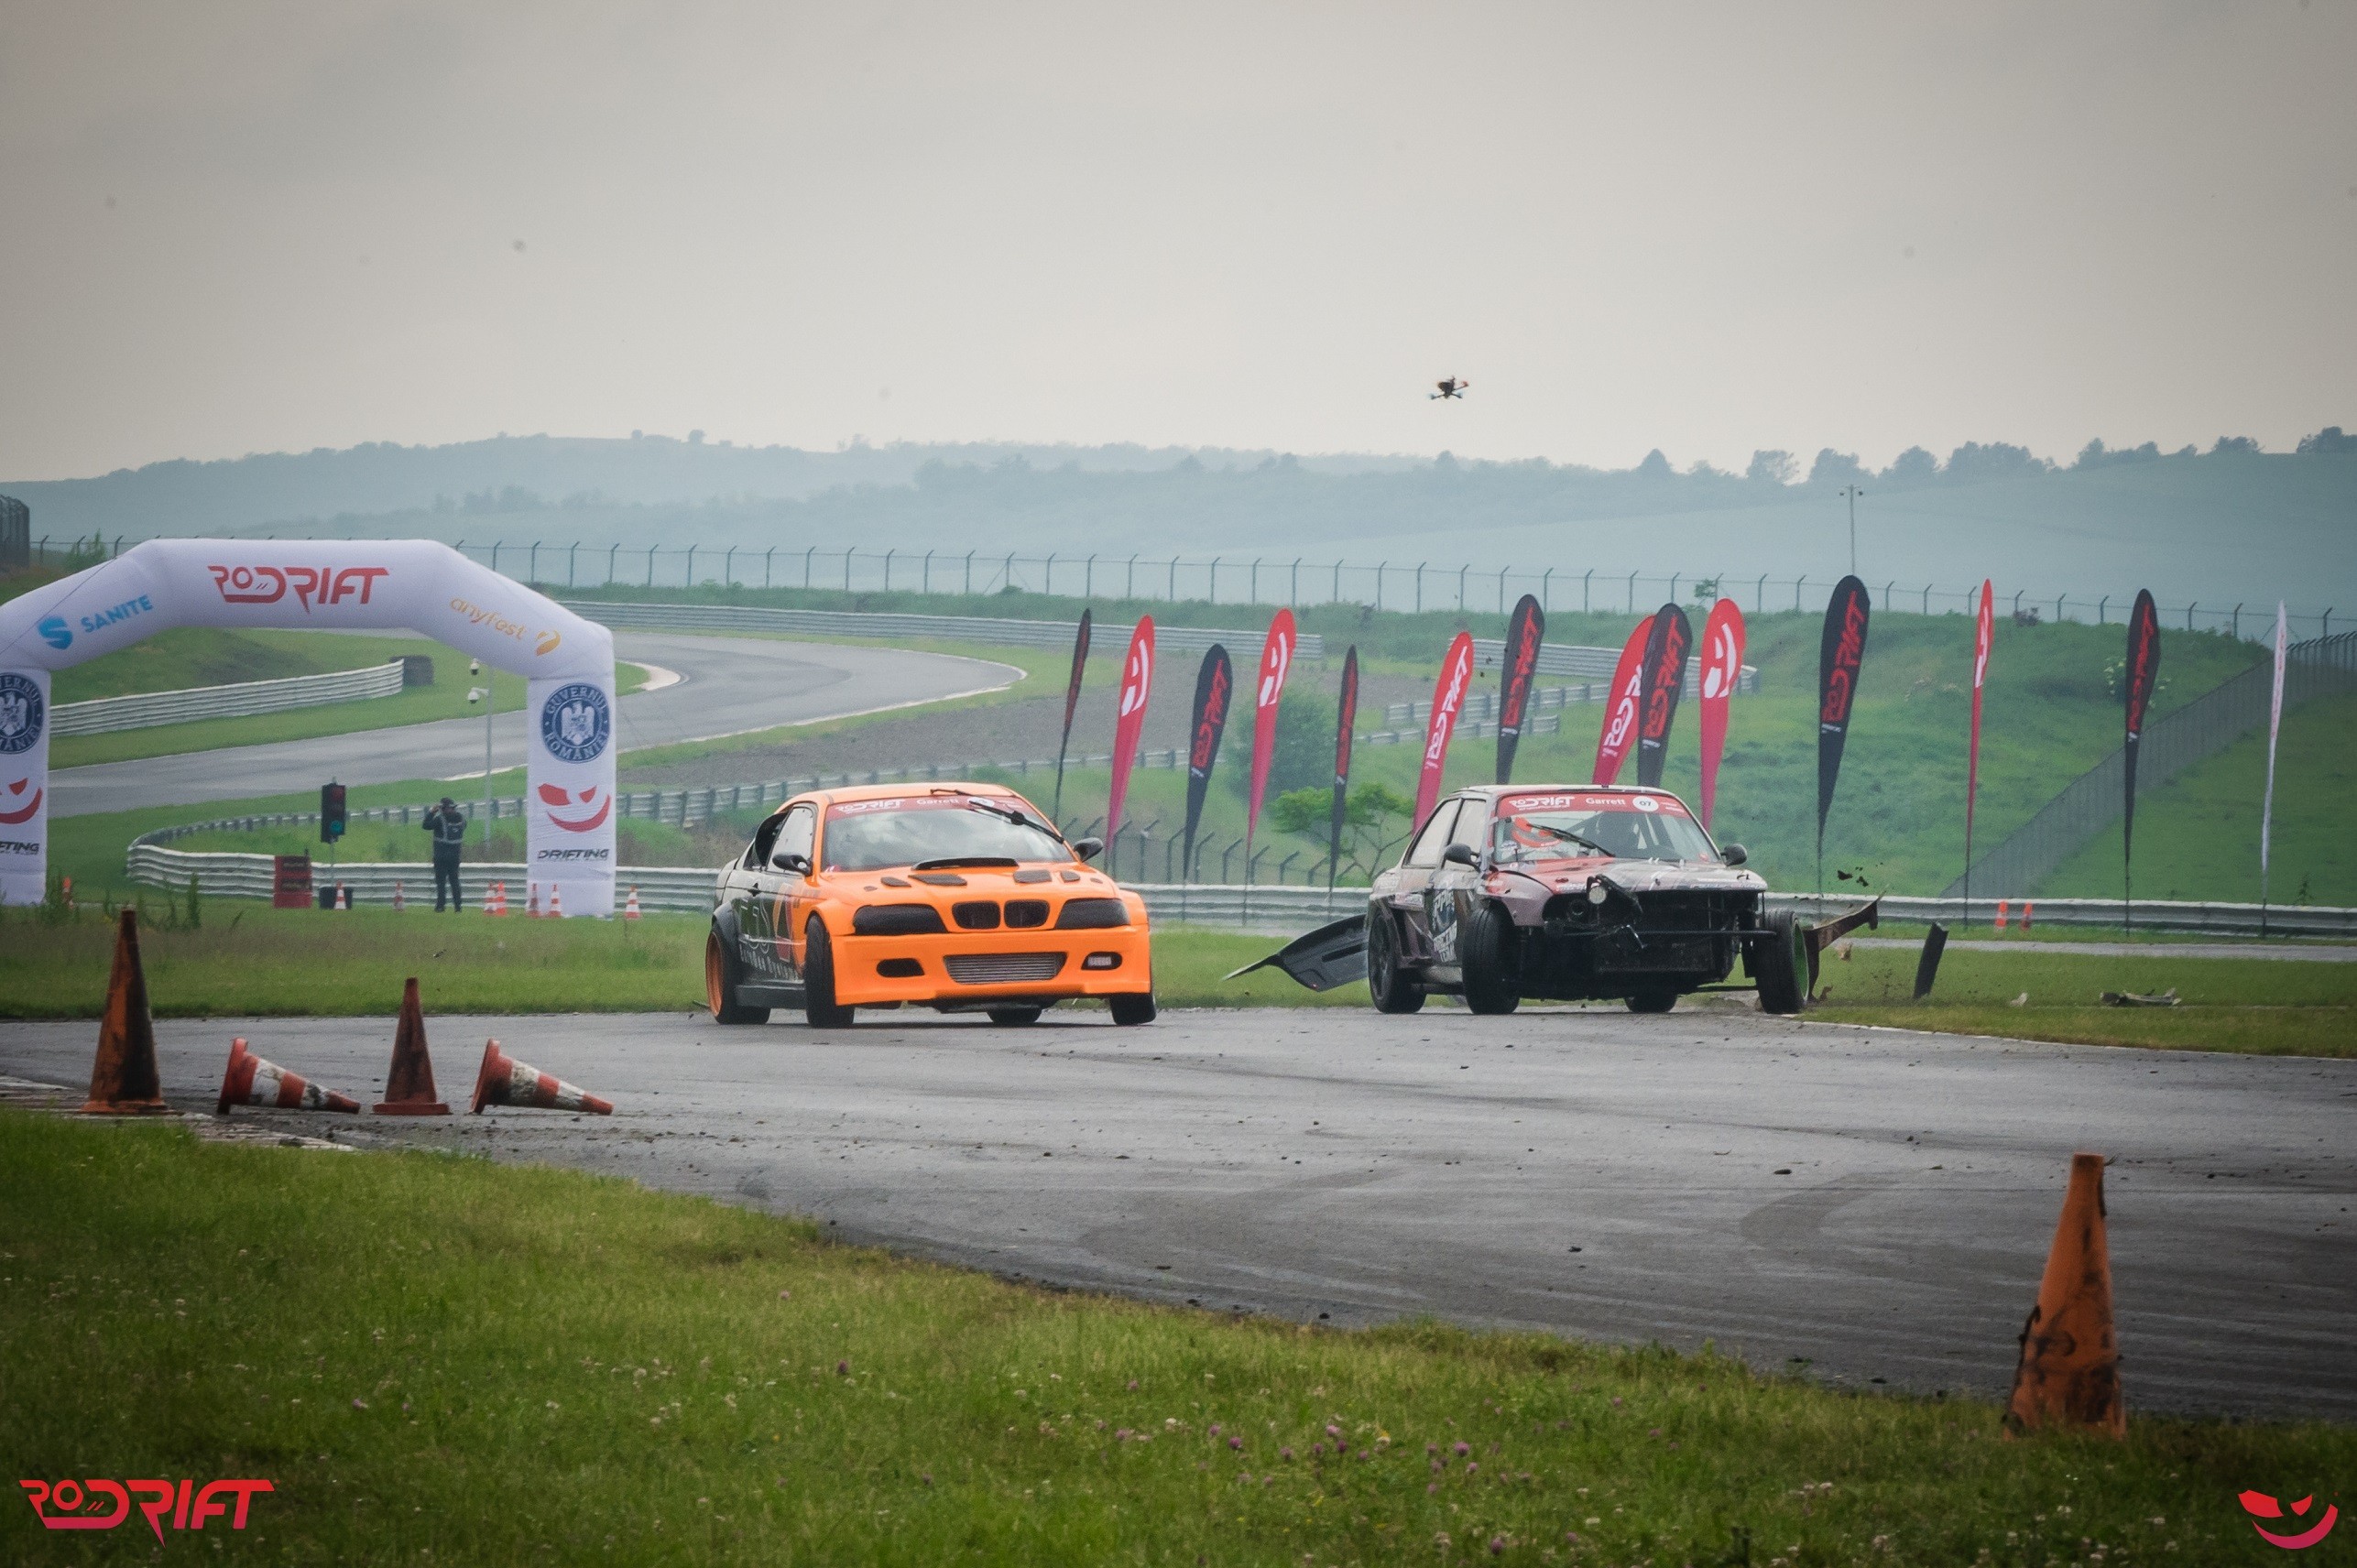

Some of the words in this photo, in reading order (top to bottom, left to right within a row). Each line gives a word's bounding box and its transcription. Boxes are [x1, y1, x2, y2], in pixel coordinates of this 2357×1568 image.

[208, 565, 388, 614] RODRIFT
[81, 594, 153, 633] SANITE
[450, 598, 527, 640] anyfast
[916, 797, 959, 806] Garrett
[1509, 796, 1575, 809] RODRIFT
[1585, 797, 1626, 806] Garrett
[538, 848, 609, 859] DRIFTING
